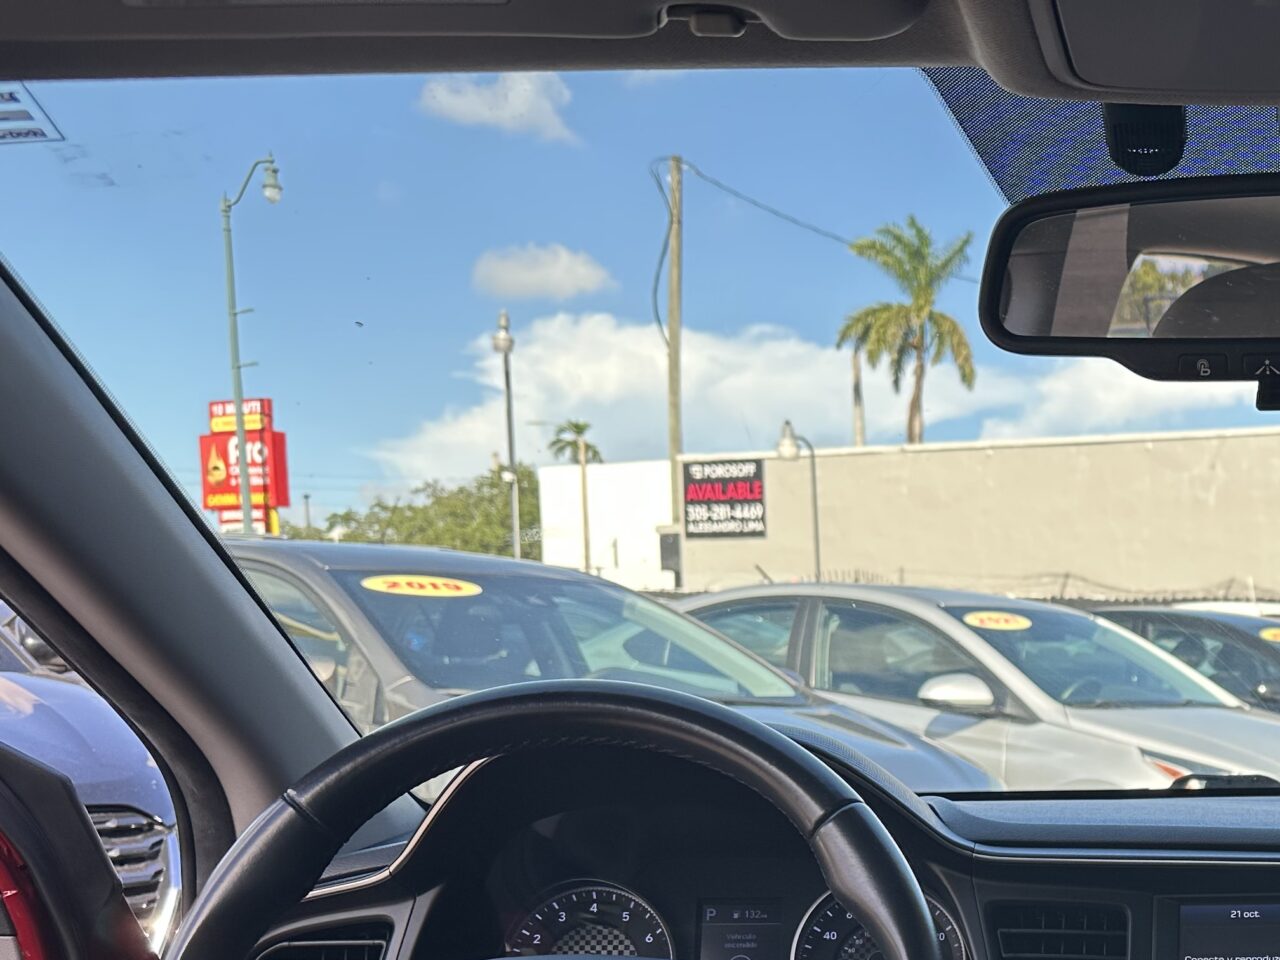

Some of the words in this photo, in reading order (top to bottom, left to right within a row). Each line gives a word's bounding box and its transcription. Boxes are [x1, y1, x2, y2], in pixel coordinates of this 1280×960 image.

[687, 480, 762, 502] AVAILABLE
[589, 902, 598, 913] 4
[558, 911, 566, 922] 3
[622, 910, 630, 922] 5
[706, 908, 717, 921] P
[1230, 910, 1241, 918] 21
[1243, 910, 1260, 918] oct.
[533, 934, 542, 944] 2
[645, 933, 654, 944] 6
[823, 931, 838, 941] 40
